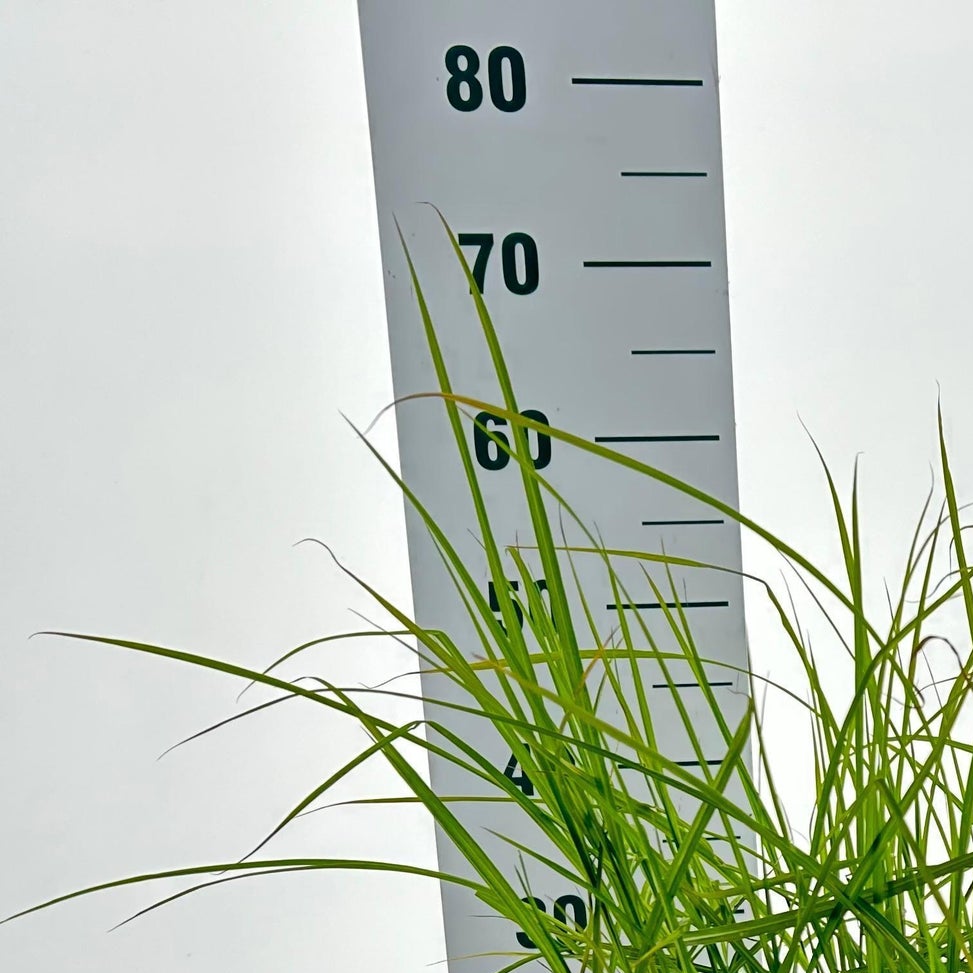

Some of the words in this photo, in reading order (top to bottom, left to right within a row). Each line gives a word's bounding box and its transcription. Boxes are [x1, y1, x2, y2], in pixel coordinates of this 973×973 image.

[445, 44, 527, 113] 80
[458, 232, 539, 295] 70
[473, 409, 552, 471] 60
